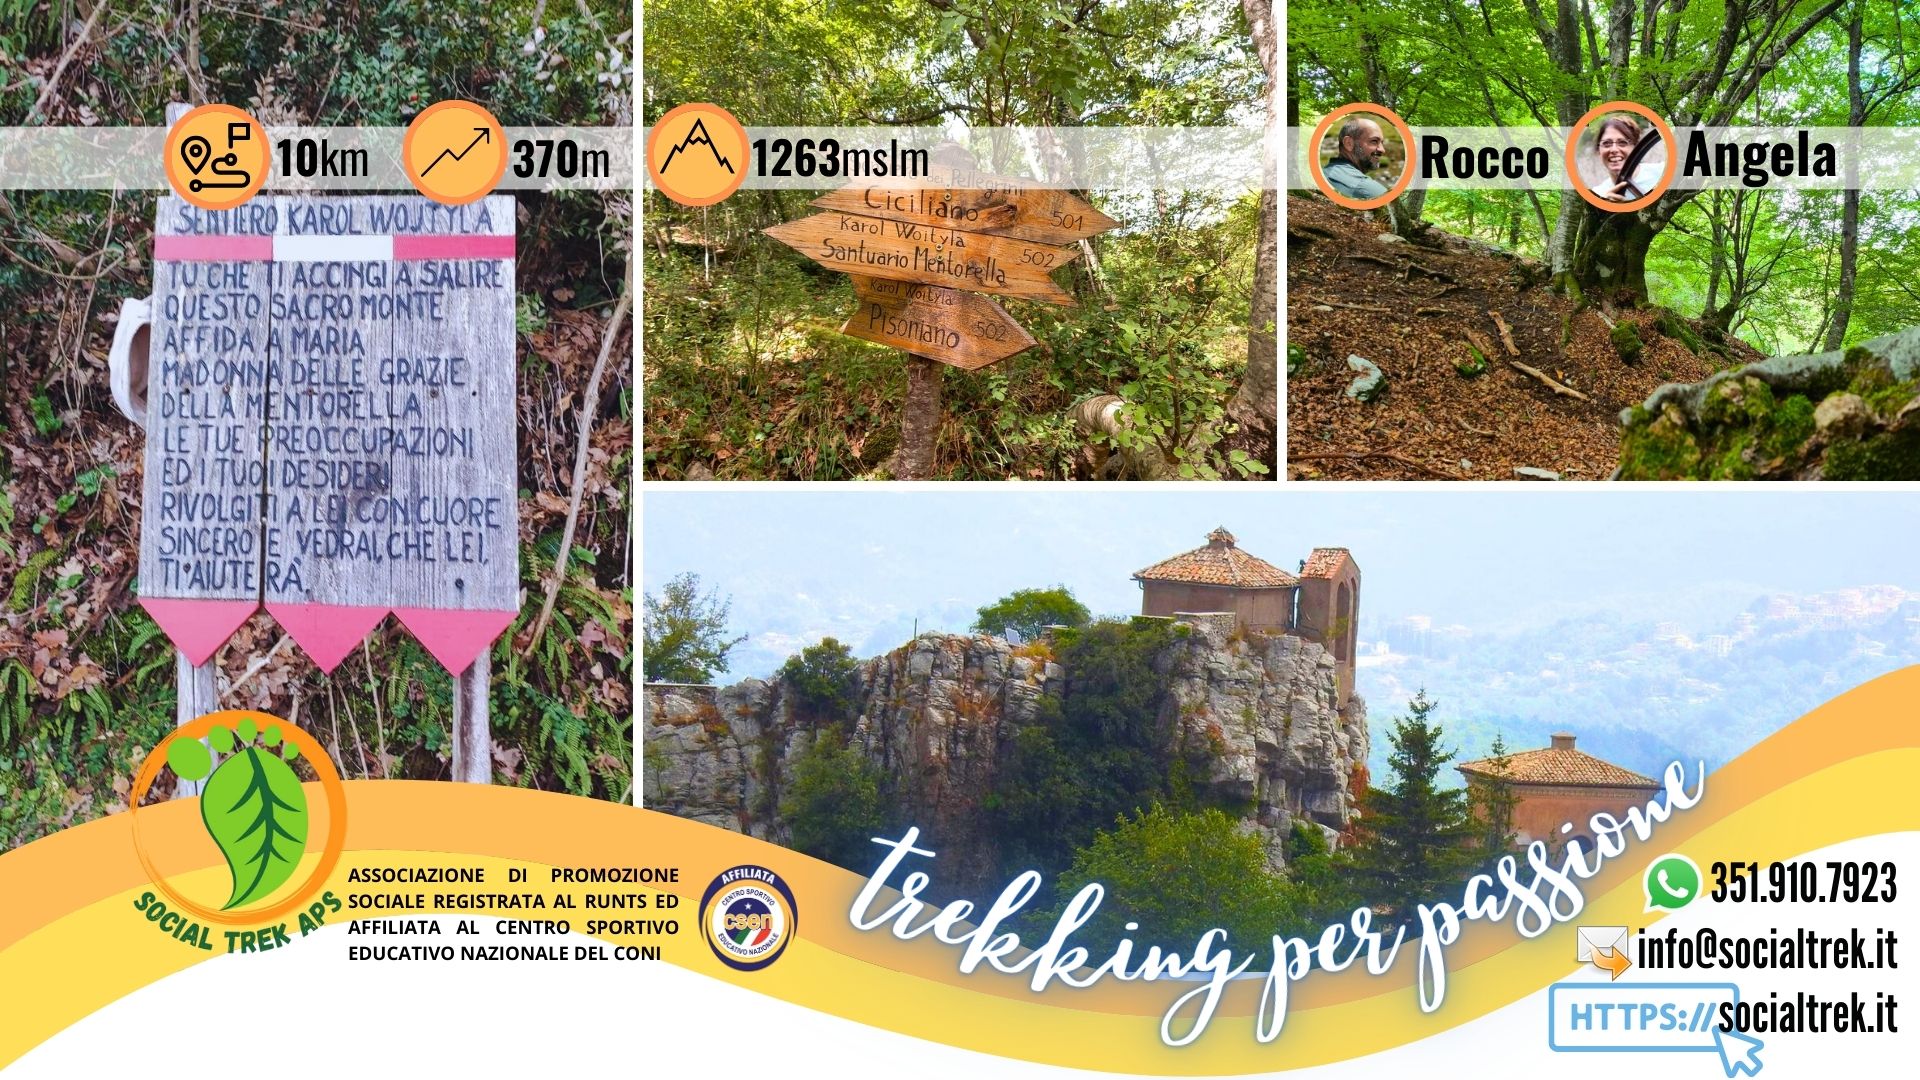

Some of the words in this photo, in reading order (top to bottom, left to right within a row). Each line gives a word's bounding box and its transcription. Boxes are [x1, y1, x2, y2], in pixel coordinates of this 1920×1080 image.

[174, 204, 278, 236] SENTIERO
[288, 203, 361, 235] KAROL
[370, 202, 493, 234] WOJTYLA
[864, 185, 979, 222] Ciciliano
[840, 215, 884, 236] Karol
[895, 222, 966, 248] Woityla
[1050, 211, 1083, 231] 501
[820, 237, 908, 268] Santuario
[914, 246, 1006, 283] Mentorella
[1020, 248, 1055, 268] 502
[168, 261, 198, 289] TU
[207, 261, 249, 289] CHE
[264, 261, 283, 289] TI
[292, 261, 387, 289] ACCINGI
[395, 261, 412, 288] A
[420, 260, 503, 289] SALIRE
[164, 293, 261, 322] QUESTO
[271, 293, 353, 321] SACRO
[360, 292, 444, 321] MONTE
[870, 280, 899, 294] Karol
[905, 283, 953, 306] Woityla
[164, 326, 254, 352] AFFIDA
[265, 327, 283, 354] A
[291, 327, 365, 355] MARIA
[869, 303, 960, 348] Pisoniano
[975, 321, 1007, 342] 502
[162, 359, 283, 387] MADONNA
[291, 359, 364, 388] DELLE
[379, 357, 466, 386] GRAZIE
[162, 392, 235, 419] DELLA
[245, 391, 422, 420] MENTORELLA
[163, 426, 190, 453] LE
[199, 425, 244, 453] TUE
[258, 426, 473, 457] PREOCCUPAZIONI
[162, 459, 191, 487] ED
[199, 459, 206, 486] I
[217, 458, 275, 487] TUOI
[282, 459, 389, 489] DESIDERI
[160, 492, 278, 522] RIVOLGITI
[287, 493, 303, 522] A
[312, 494, 347, 524] LEI
[356, 498, 409, 525] CON
[416, 497, 501, 529] CUORE
[159, 527, 253, 557] SINCERO
[268, 529, 282, 557] E
[296, 528, 383, 564] VEDRAI,
[387, 531, 436, 561] CHE
[447, 532, 489, 565] LEI,
[160, 558, 180, 589] TI
